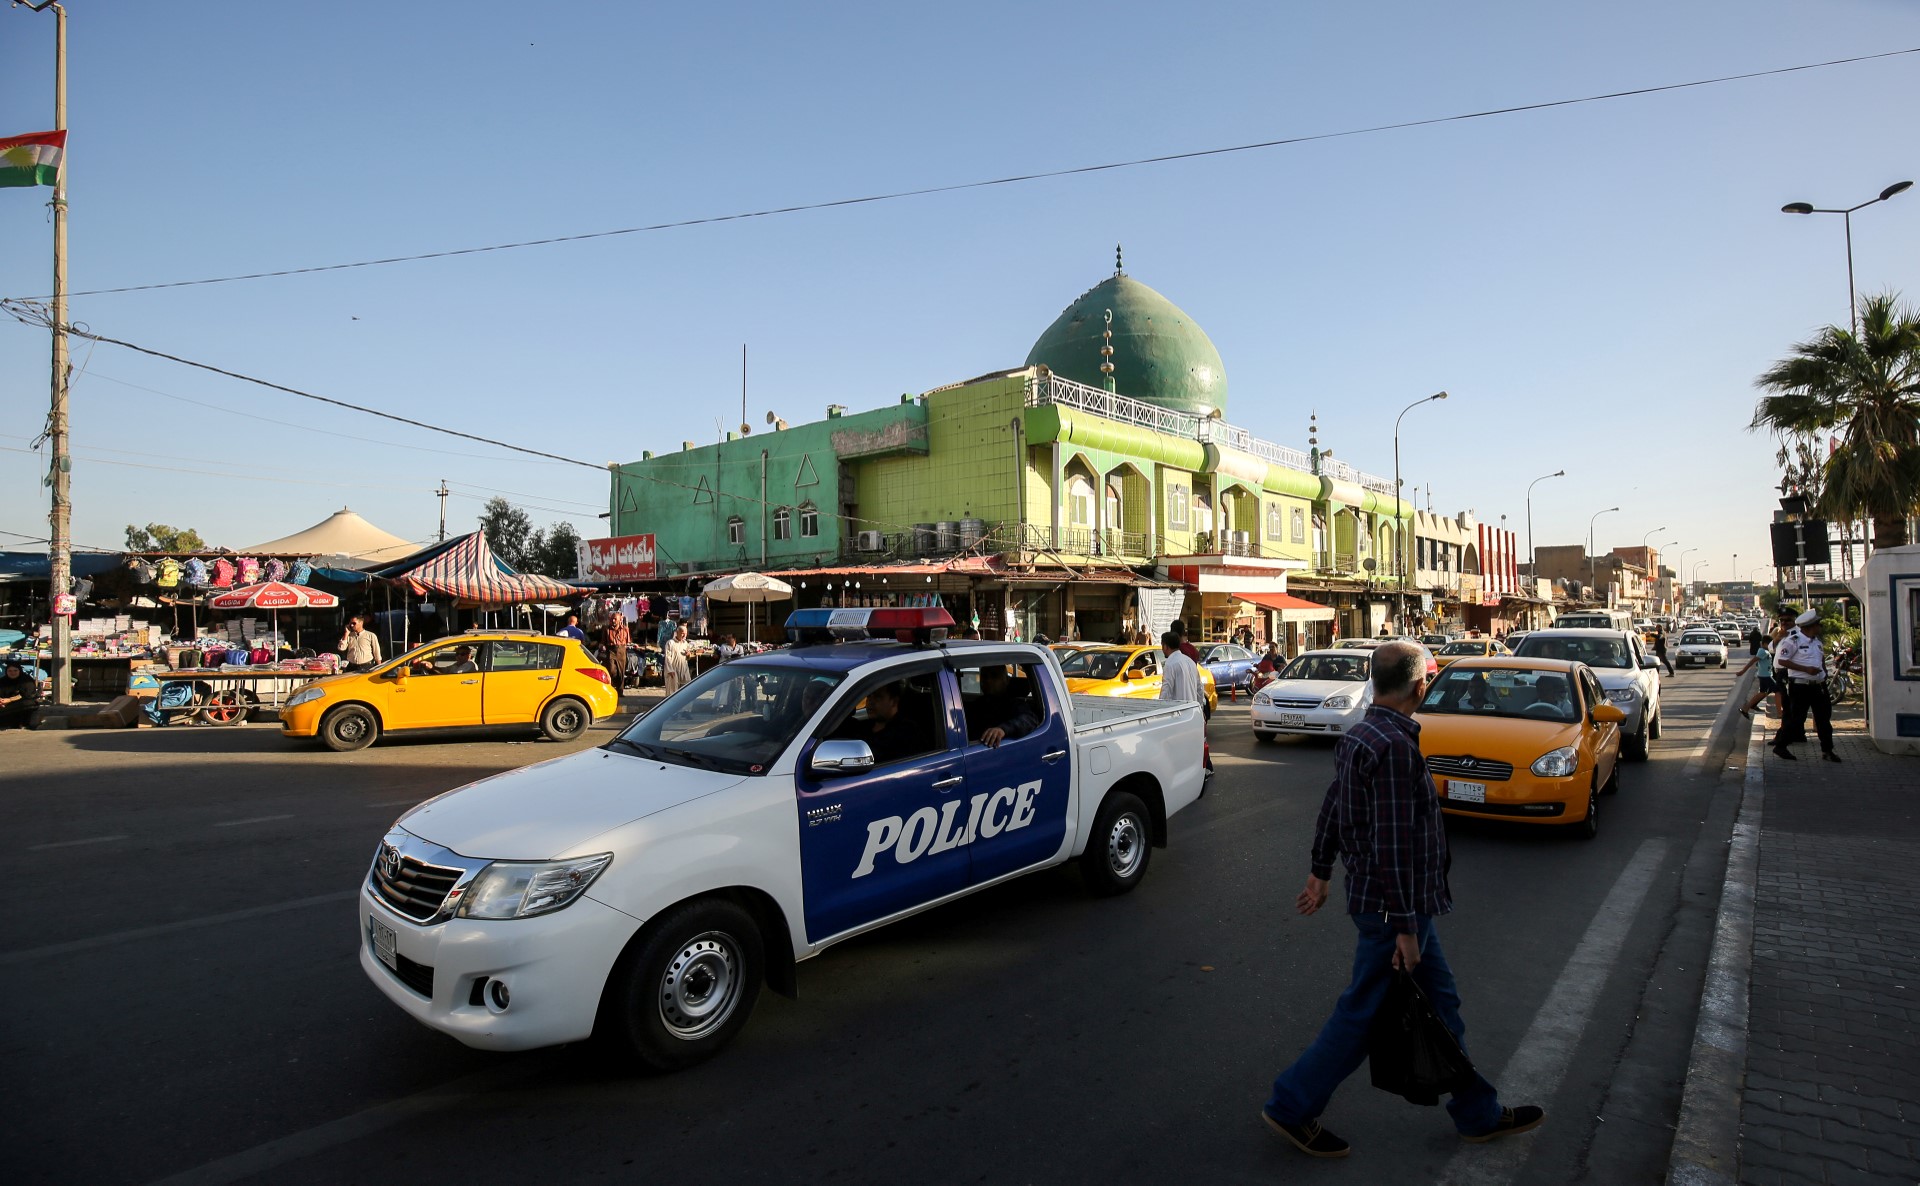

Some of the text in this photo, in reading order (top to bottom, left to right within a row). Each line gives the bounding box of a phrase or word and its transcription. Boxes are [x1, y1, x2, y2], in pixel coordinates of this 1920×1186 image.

[592, 536, 654, 571] مأكولات البركة
[806, 803, 842, 819] HILUX
[851, 779, 1043, 879] POLICE
